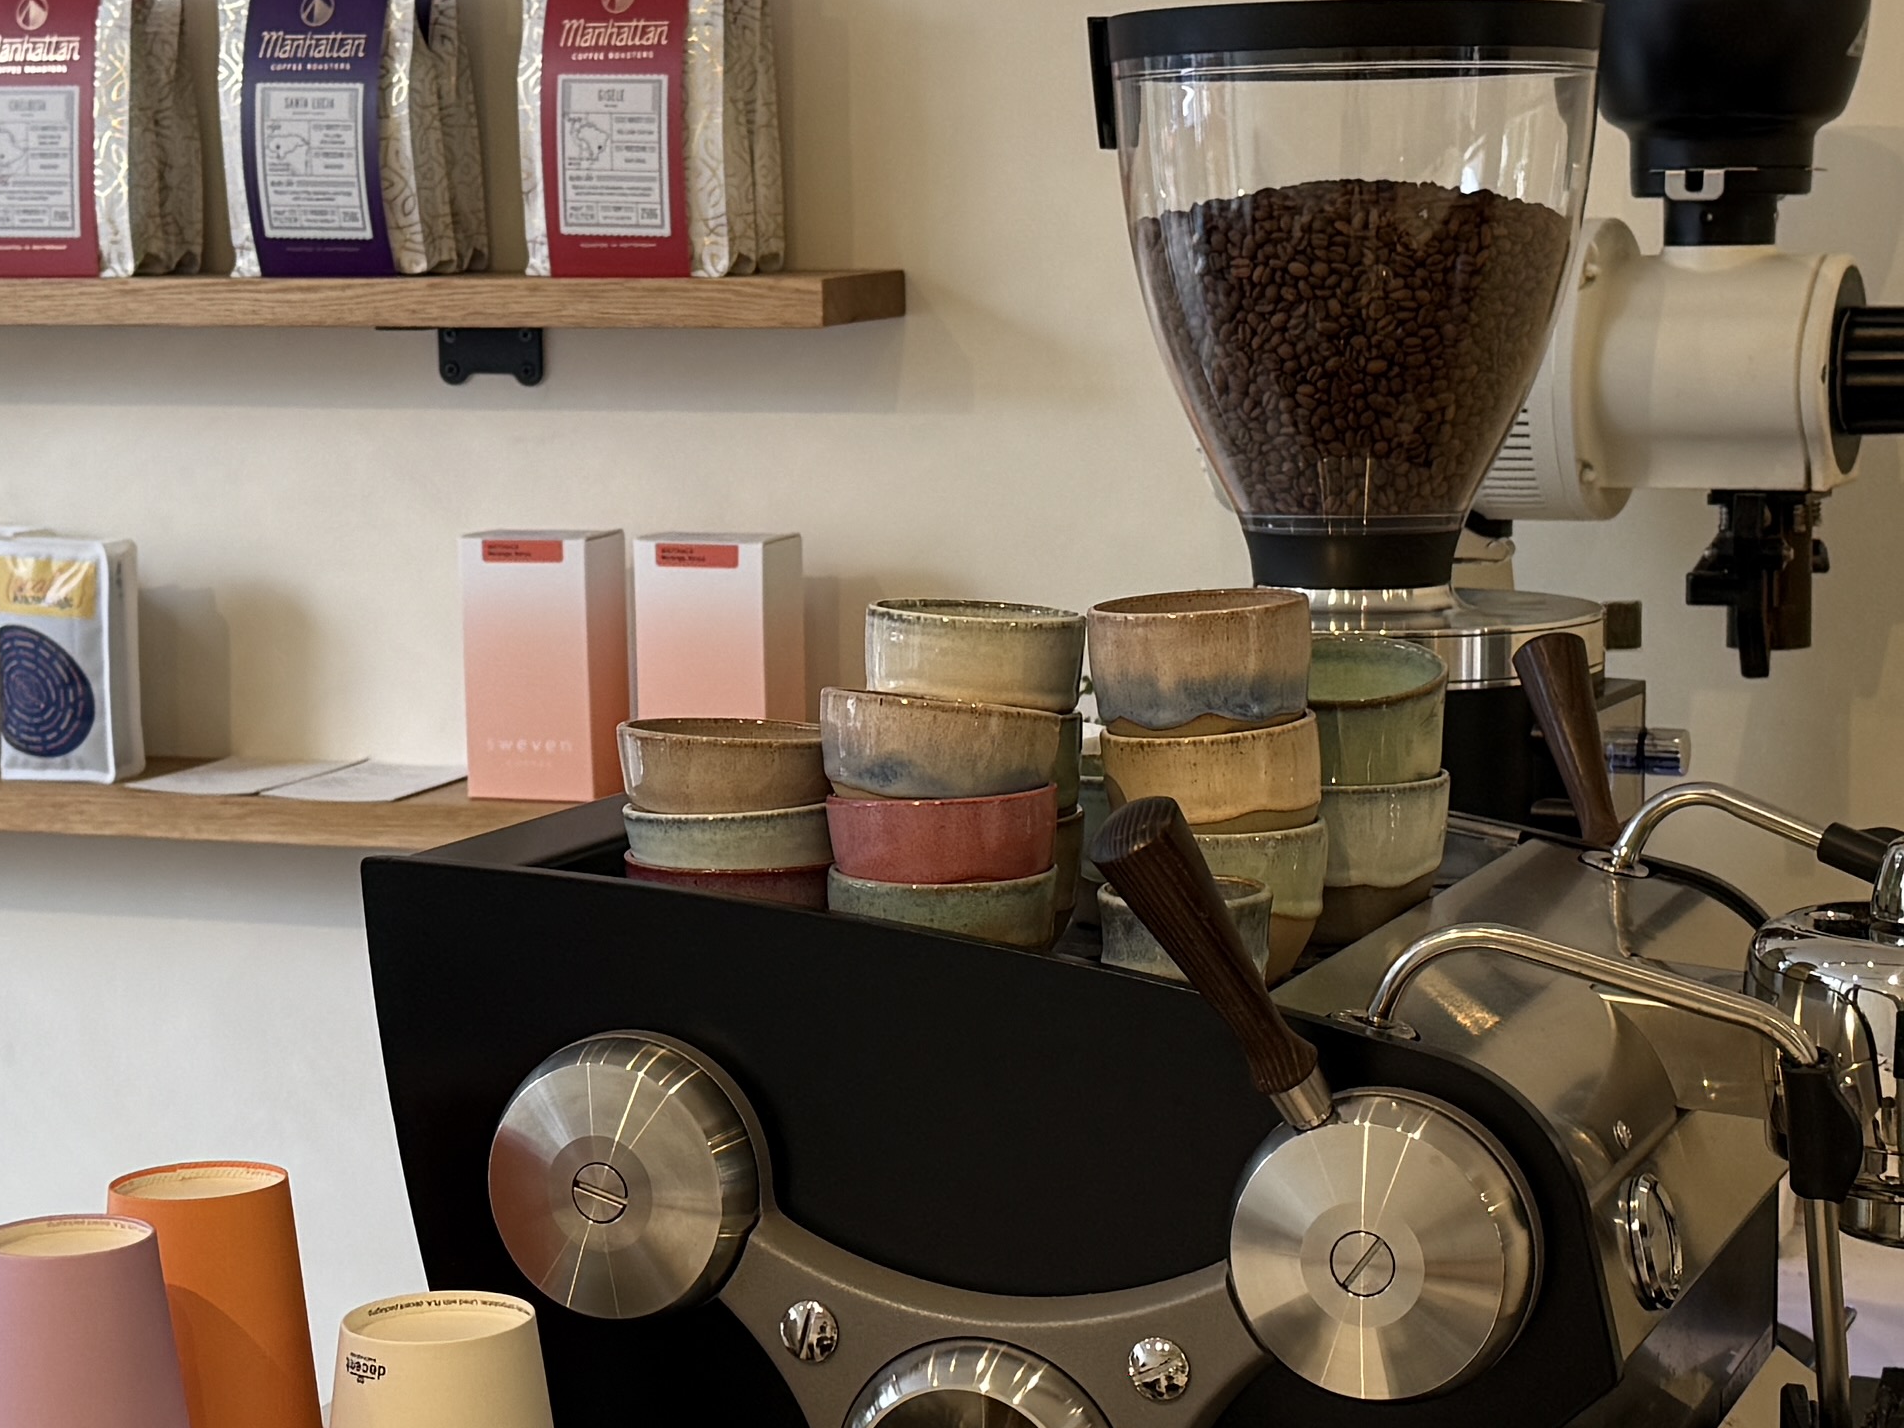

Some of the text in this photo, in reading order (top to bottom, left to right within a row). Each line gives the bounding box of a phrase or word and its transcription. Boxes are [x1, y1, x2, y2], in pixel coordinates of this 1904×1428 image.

[559, 18, 670, 47] Manhattan
[258, 30, 367, 59] Manhattan
[571, 51, 654, 61] COFFEE ROASTERS
[270, 63, 351, 71] COFFEE ROASTERS
